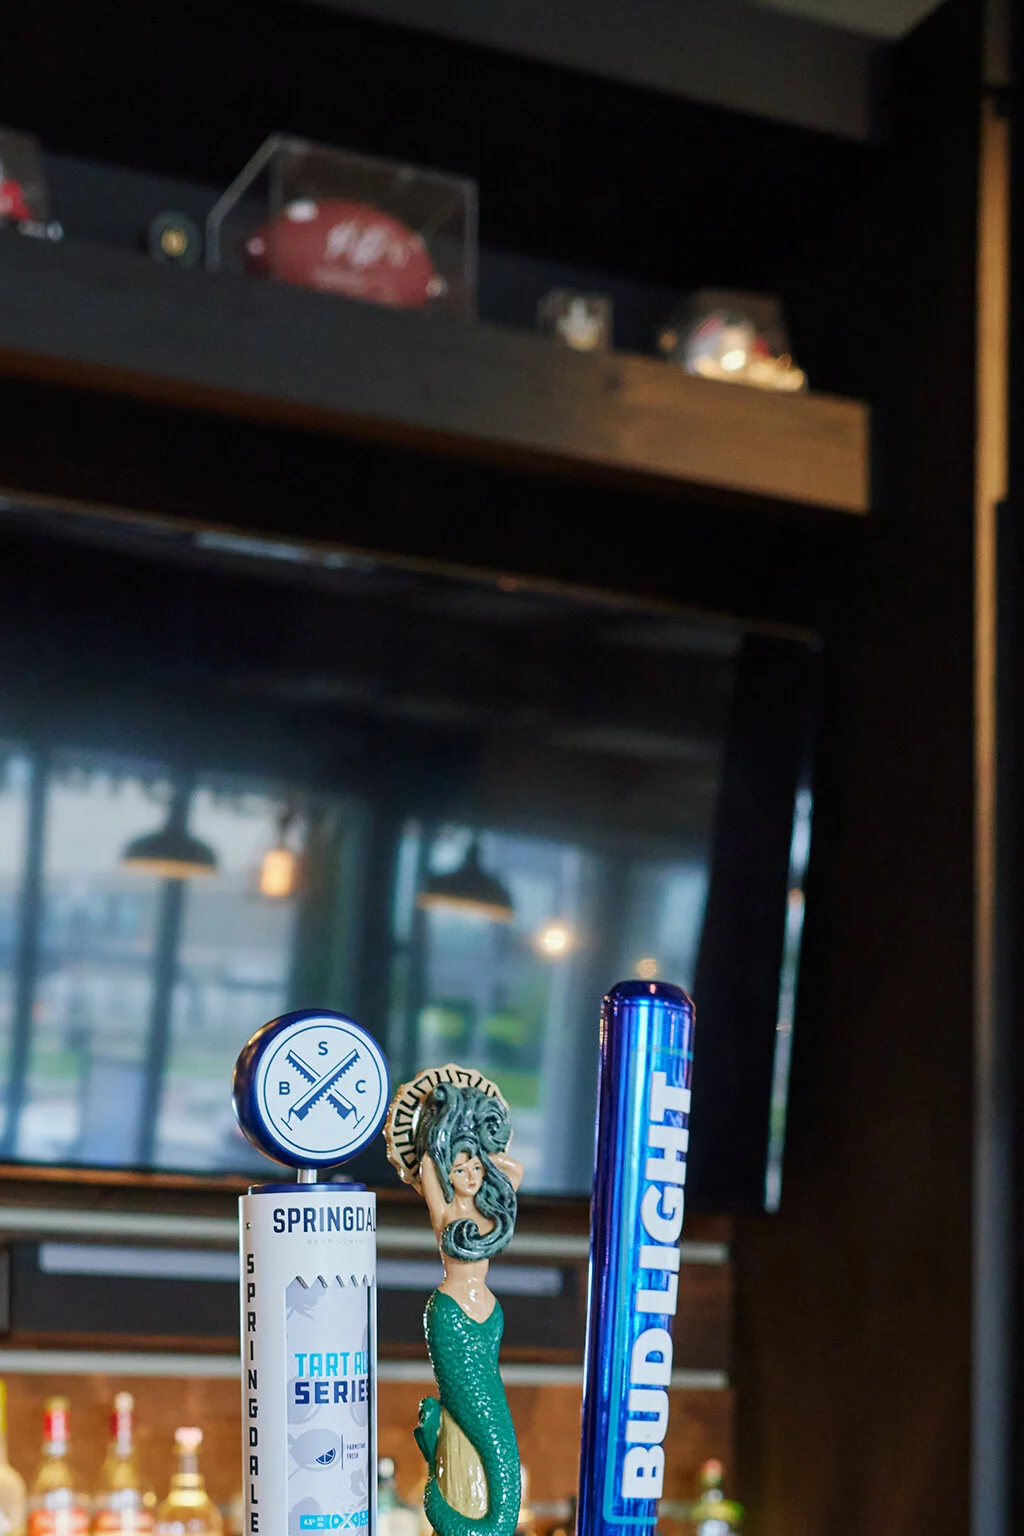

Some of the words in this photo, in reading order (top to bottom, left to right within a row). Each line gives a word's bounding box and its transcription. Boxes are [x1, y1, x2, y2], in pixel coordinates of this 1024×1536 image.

[318, 1041, 329, 1056] S
[278, 1081, 291, 1095] B
[355, 1079, 367, 1094] C
[635, 1071, 693, 1317] LIGHT
[273, 1206, 376, 1233] SPRINGDAL
[294, 1352, 350, 1377] TART
[245, 1253, 259, 1533] SPRINGDALE
[621, 1327, 674, 1499] BUD
